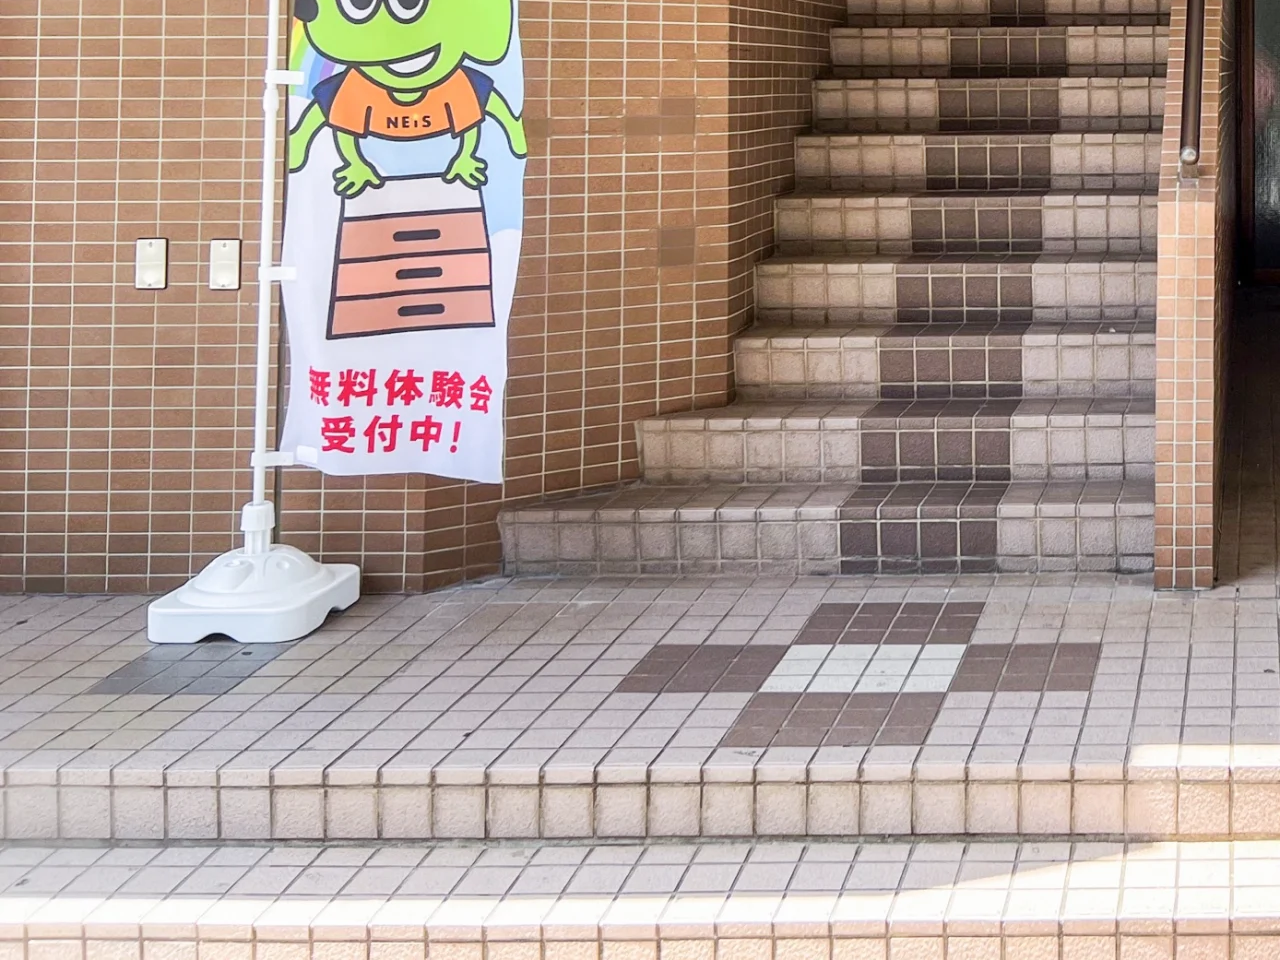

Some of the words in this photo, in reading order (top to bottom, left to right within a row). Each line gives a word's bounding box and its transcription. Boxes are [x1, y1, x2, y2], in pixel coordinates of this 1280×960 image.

[307, 366, 493, 415] 無料体験会
[319, 414, 463, 455] 受付中!
